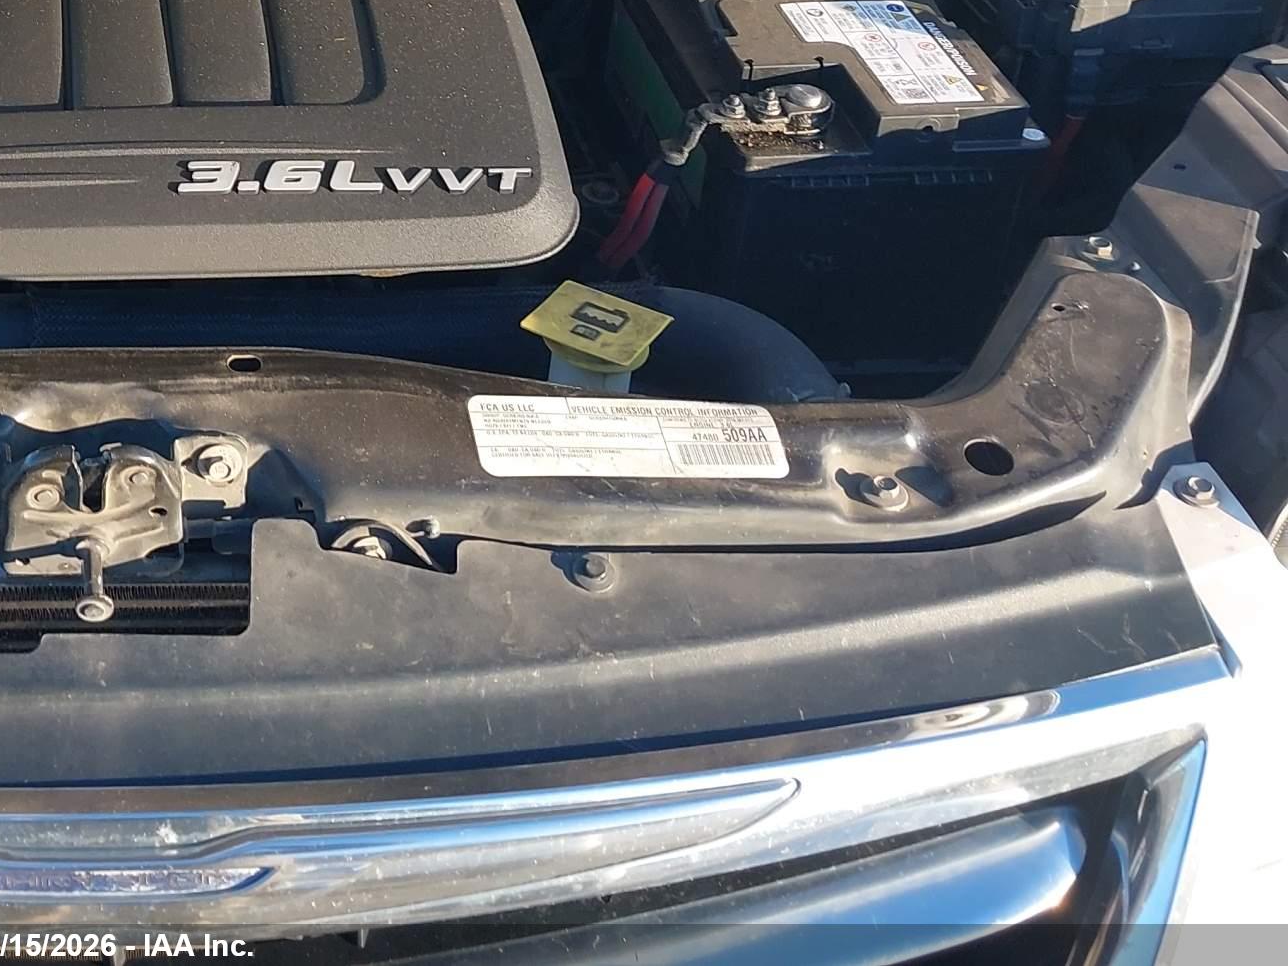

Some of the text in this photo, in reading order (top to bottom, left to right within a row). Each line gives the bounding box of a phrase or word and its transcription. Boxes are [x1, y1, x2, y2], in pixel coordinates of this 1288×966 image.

[502, 404, 515, 412] US
[517, 404, 535, 412] LLC
[571, 406, 758, 416] VEHICLE EMISSION CONTROL INFORMATION
[722, 428, 767, 442] 509AA
